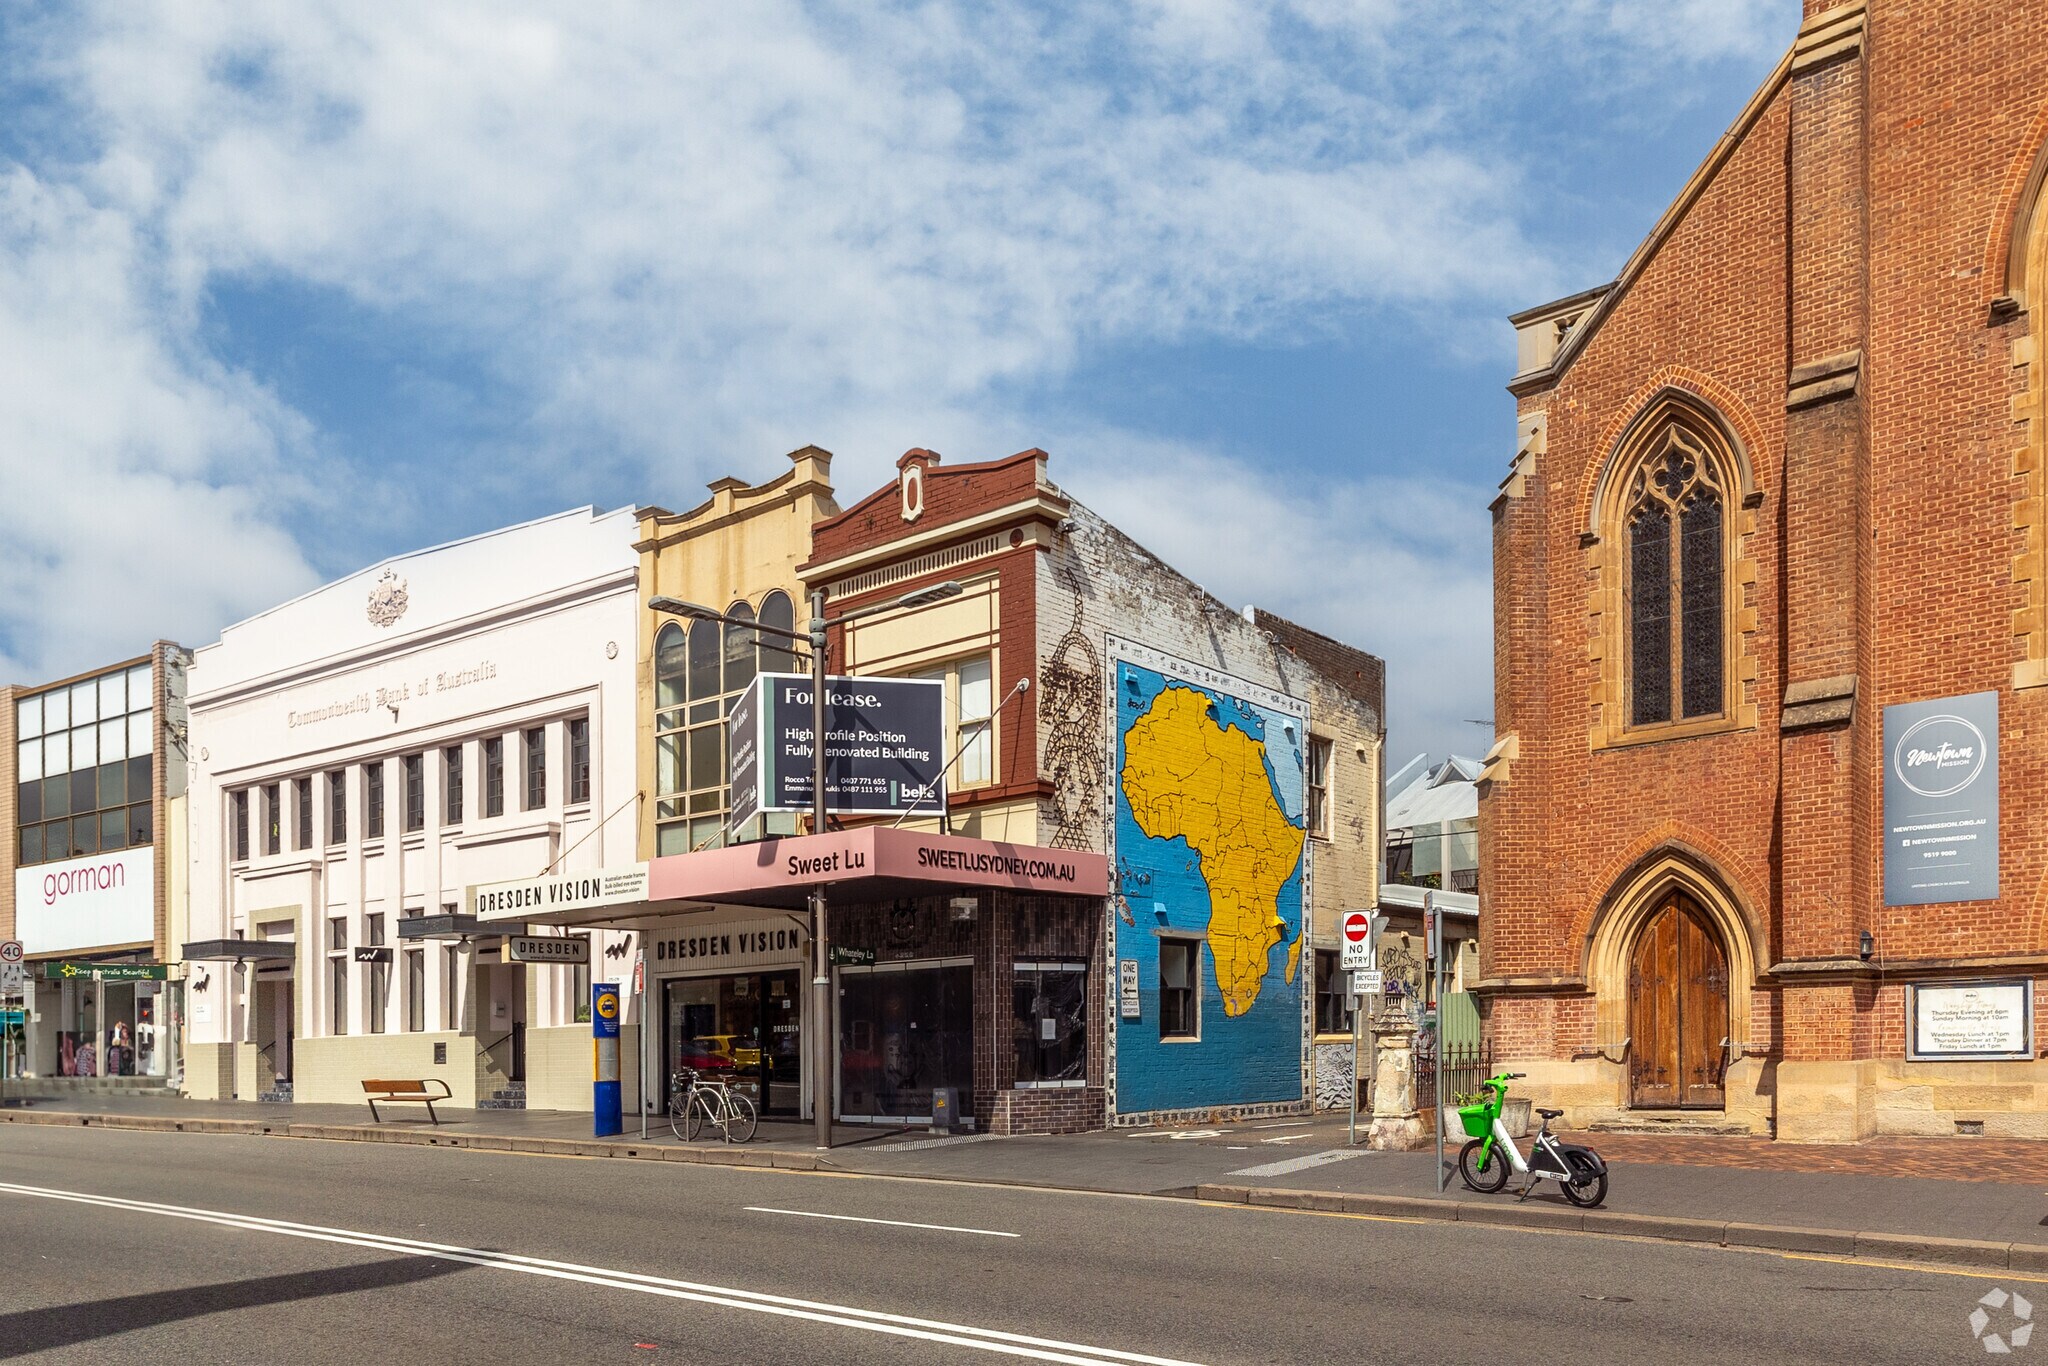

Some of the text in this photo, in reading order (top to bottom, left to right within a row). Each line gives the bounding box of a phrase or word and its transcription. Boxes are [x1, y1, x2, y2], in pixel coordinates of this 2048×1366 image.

[288, 660, 497, 728] Commonwealth Bank of Australia
[825, 689, 882, 708] lease.
[825, 730, 855, 742] rofile
[858, 730, 906, 743] Position
[785, 745, 930, 762] Fully enovated Building
[1907, 742, 1973, 770] Newtown
[1893, 819, 1987, 833] NEWTOWNMISSION.ORG.AU
[1912, 834, 1977, 845] NEWTOWNMISSION
[788, 849, 865, 876] Sweet Lu
[918, 847, 1076, 882] SWEETLUSYDNEY.COM.AU
[44, 863, 124, 905] gorman
[480, 878, 601, 912] DRESDEN VISION
[520, 942, 579, 955] DRESDEN
[657, 929, 799, 960] DRESDEN VISION
[1349, 945, 1363, 954] NO
[3, 947, 21, 957] 40
[838, 947, 874, 960] Whateley La
[1344, 956, 1368, 965] ENTRY
[75, 968, 91, 977] Keep
[122, 968, 150, 978] Beautiful
[1123, 964, 1136, 973] ONE
[1123, 976, 1136, 985] WAY
[773, 1025, 800, 1033] DRESDEN
